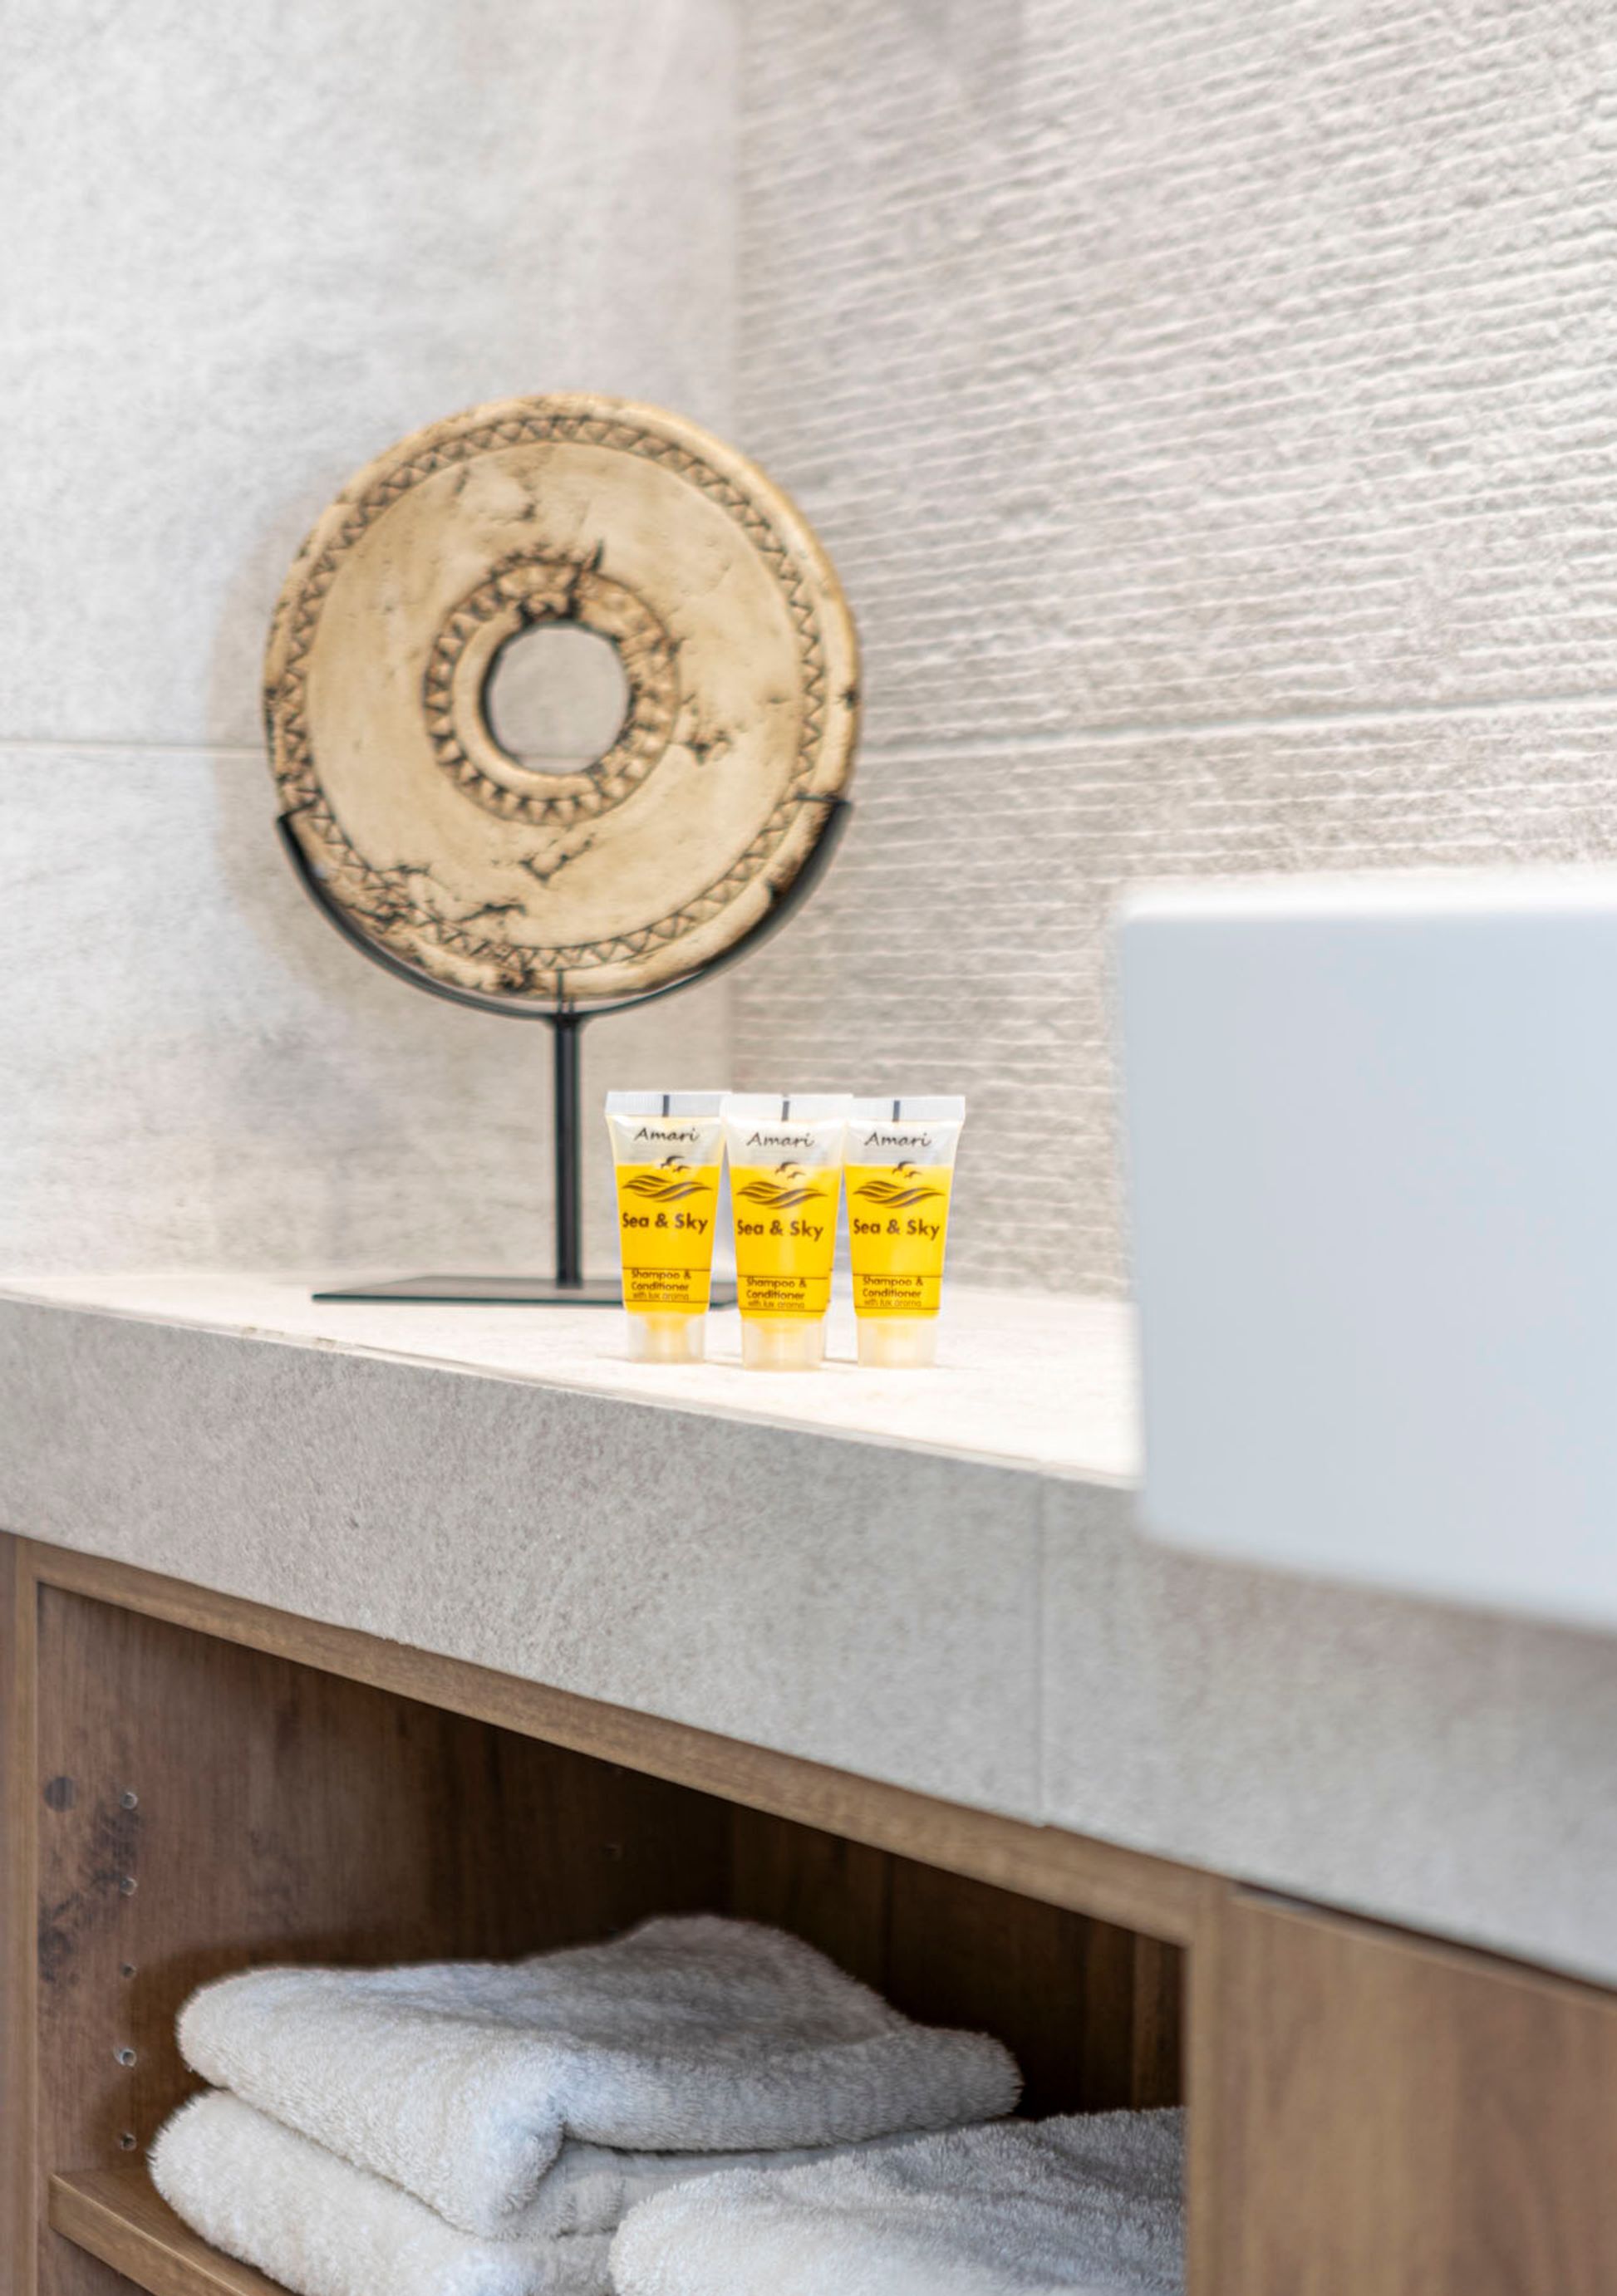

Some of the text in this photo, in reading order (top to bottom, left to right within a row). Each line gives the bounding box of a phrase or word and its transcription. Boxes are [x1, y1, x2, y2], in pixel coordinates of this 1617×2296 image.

[634, 1127, 700, 1141] Amari
[746, 1132, 814, 1147] Amari
[864, 1132, 931, 1146] Amari
[622, 1212, 709, 1235] Sea & Sky
[853, 1219, 940, 1240] Sea & Sky
[737, 1219, 824, 1242] Sea & Sky
[632, 1268, 691, 1280] Shampoo &
[632, 1281, 689, 1291] Conditioner
[747, 1276, 807, 1289] Shampoo &
[863, 1275, 924, 1288] Shampoo &
[747, 1289, 804, 1300] Conditioner
[863, 1288, 922, 1298] Conditioner
